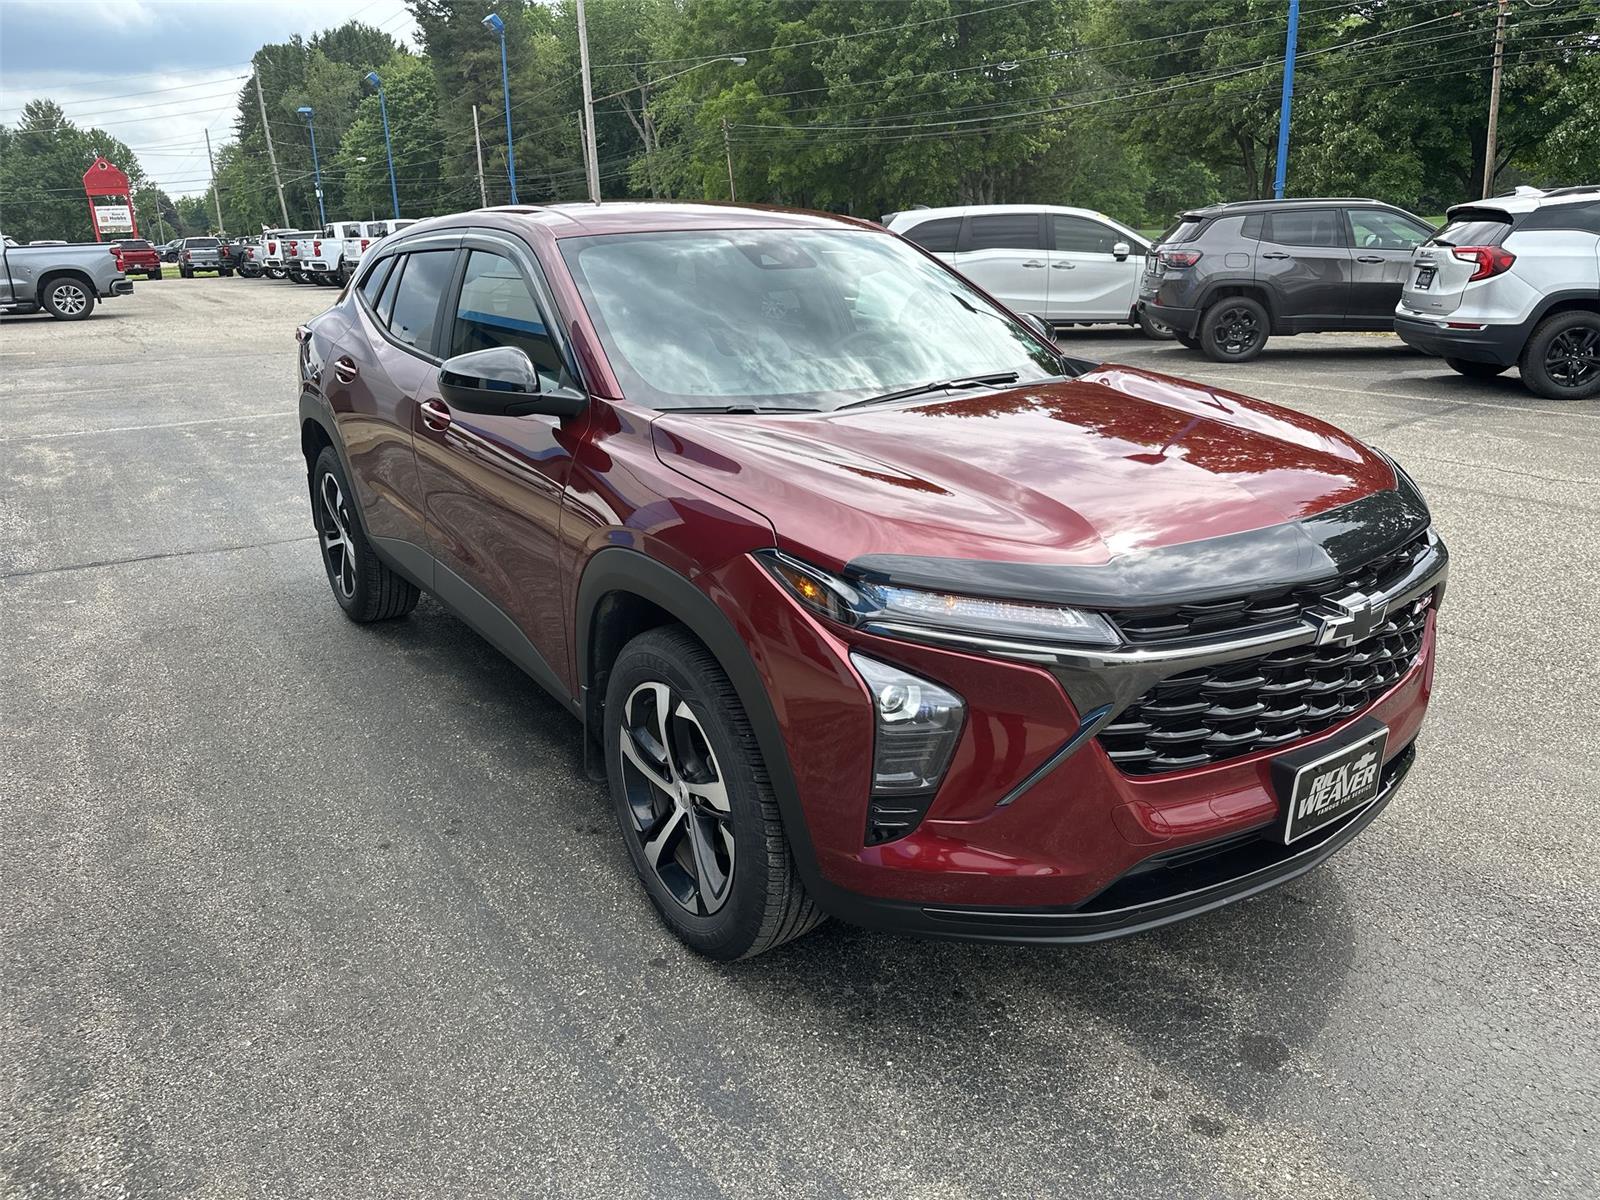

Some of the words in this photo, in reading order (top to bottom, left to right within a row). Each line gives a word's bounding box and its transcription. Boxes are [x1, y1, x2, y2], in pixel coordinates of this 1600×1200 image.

[1298, 763, 1377, 819] WEAVER
[1310, 762, 1352, 795] RICK
[1317, 801, 1339, 816] FAMOUS
